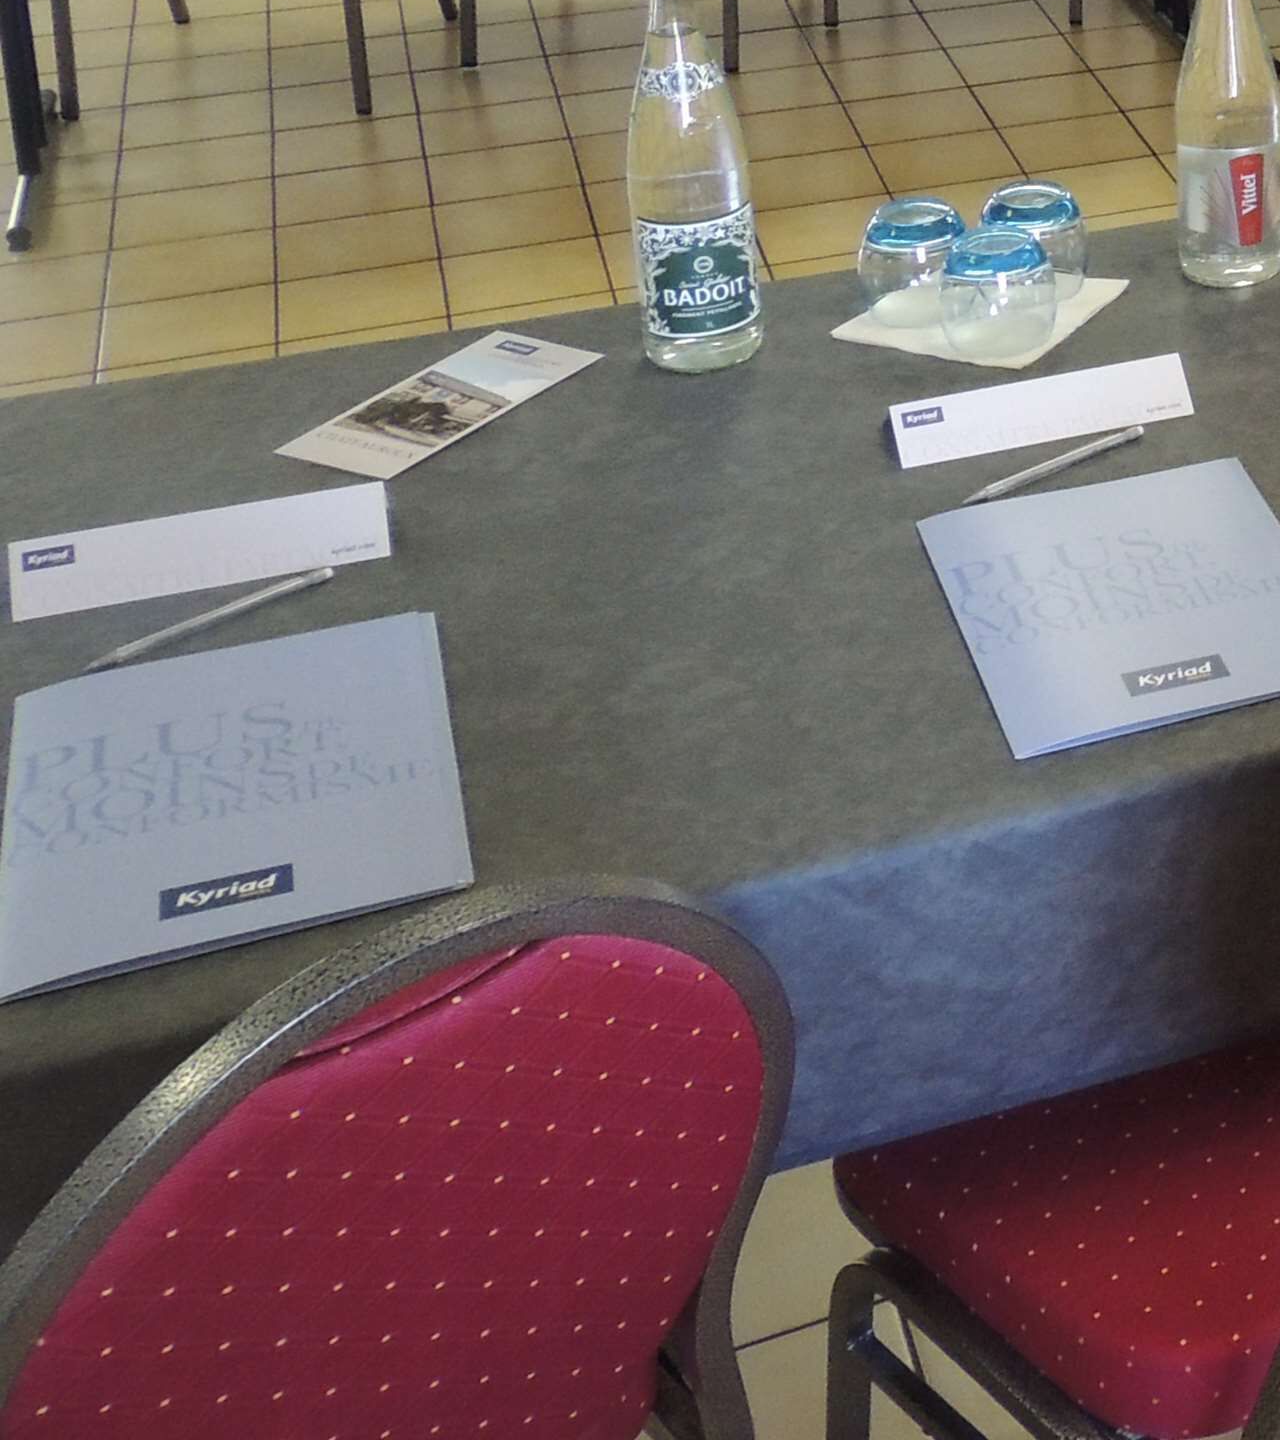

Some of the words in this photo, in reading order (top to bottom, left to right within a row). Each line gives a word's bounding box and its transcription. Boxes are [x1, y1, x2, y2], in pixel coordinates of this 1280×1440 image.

[1240, 173, 1257, 216] Vittel
[663, 276, 745, 306] BADOIT
[948, 527, 1165, 598] PLUS
[1138, 661, 1212, 687] Kyriad
[23, 700, 294, 792] PLUS
[176, 872, 278, 909] Kyriad
